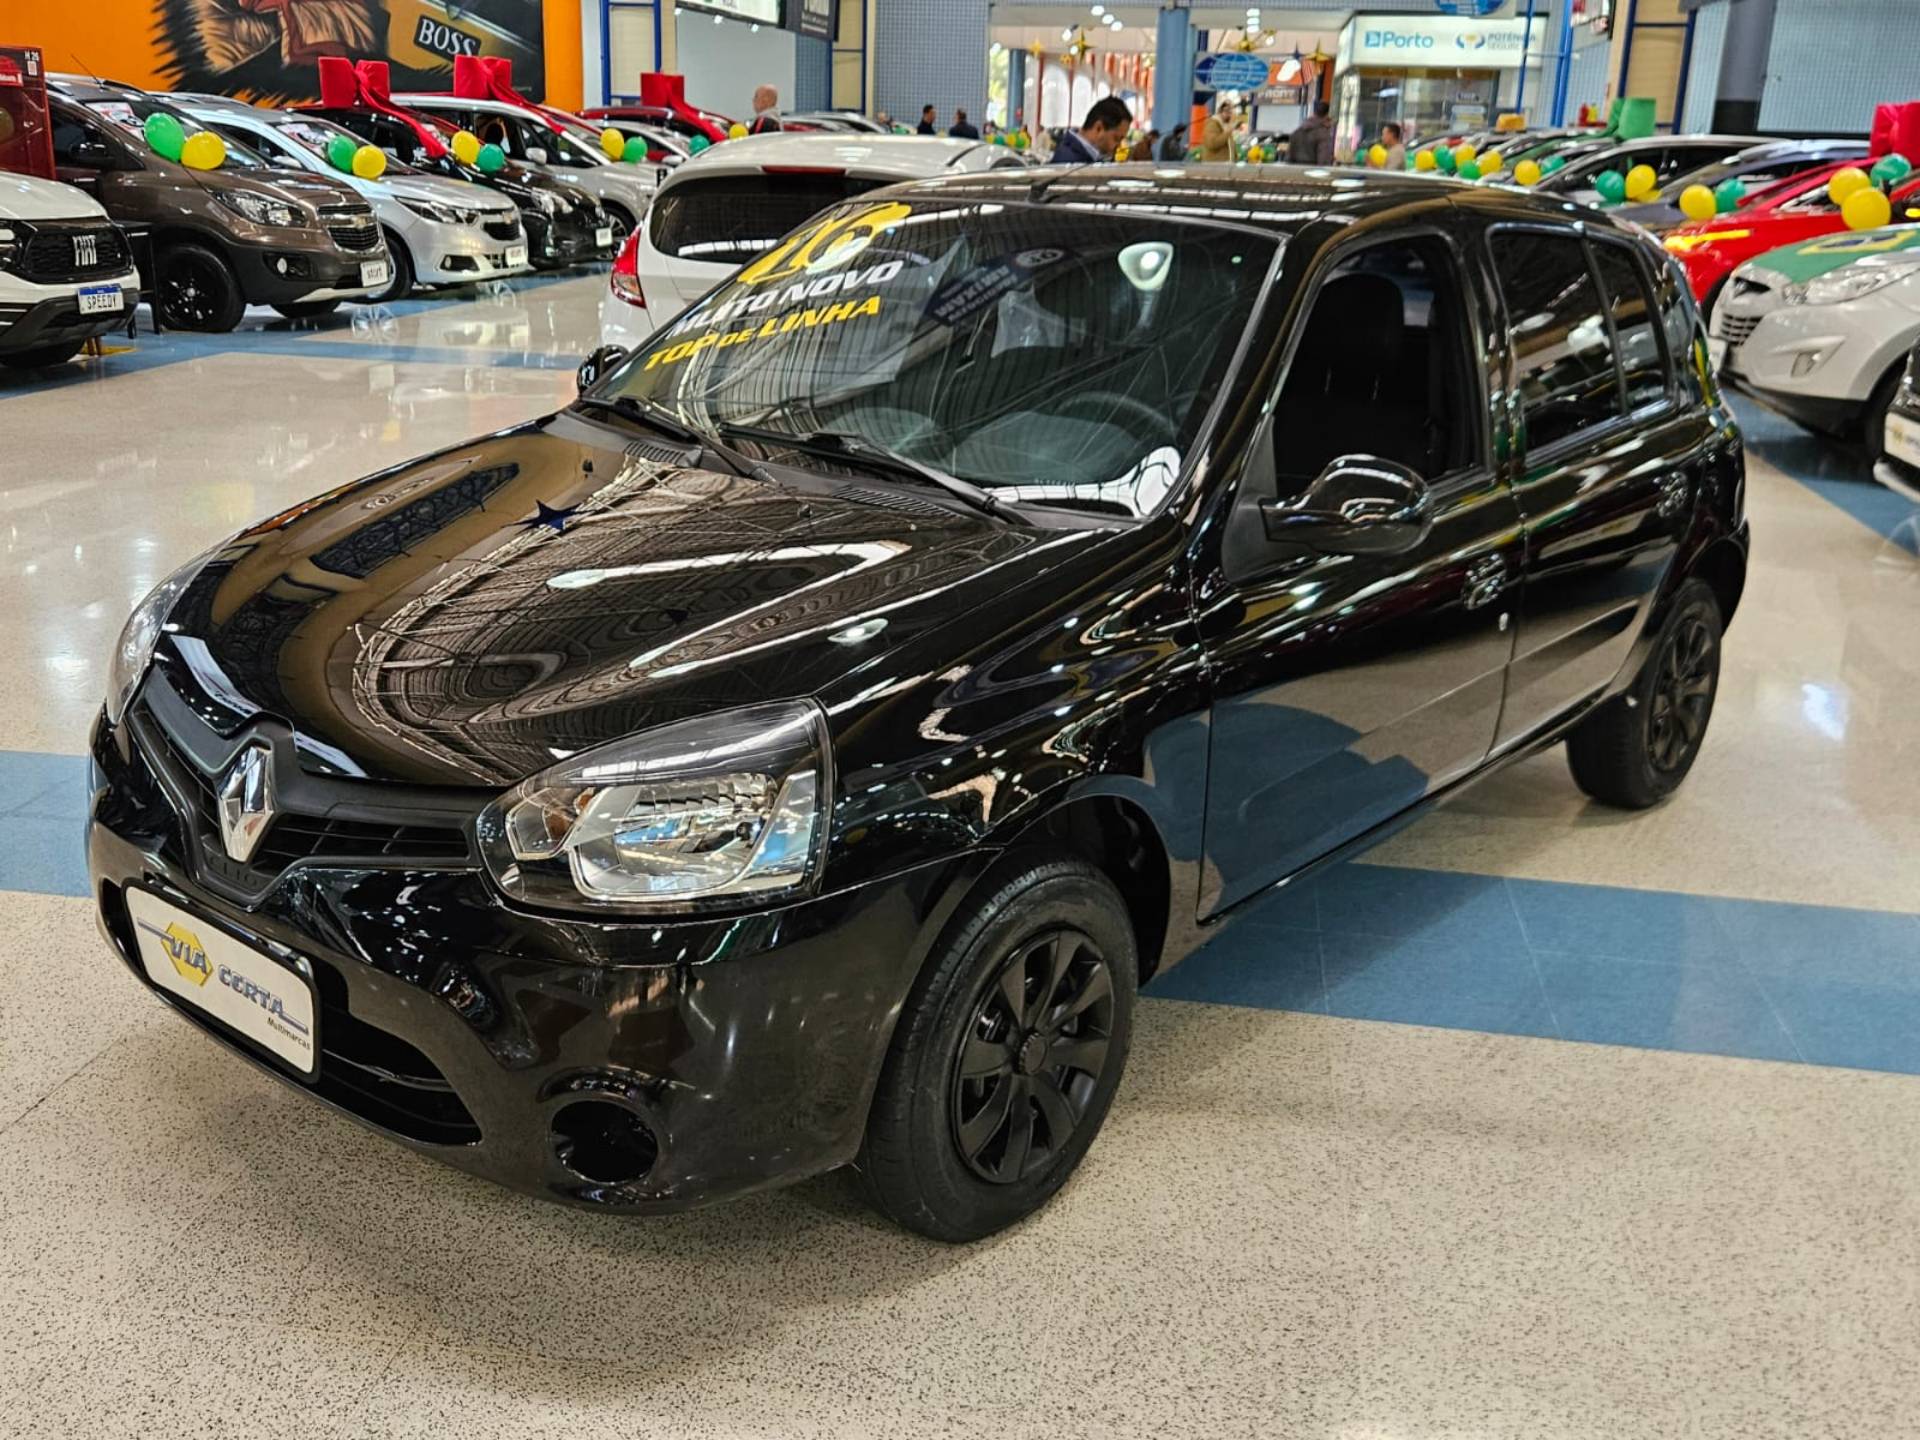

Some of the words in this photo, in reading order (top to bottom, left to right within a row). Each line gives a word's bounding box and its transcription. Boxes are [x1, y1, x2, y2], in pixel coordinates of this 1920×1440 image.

[418, 18, 476, 57] BOSS
[1383, 31, 1434, 49] Porto
[737, 202, 912, 285] 16
[86, 294, 117, 310] SPEEDY
[664, 292, 778, 340] MUITO
[779, 260, 904, 306] NOVO
[643, 332, 721, 371] TOP
[720, 328, 756, 349] DE
[757, 295, 881, 339] LINHA
[170, 936, 208, 974] VIA
[218, 963, 285, 1018] CERTA
[266, 1016, 311, 1051] Multimarcas
